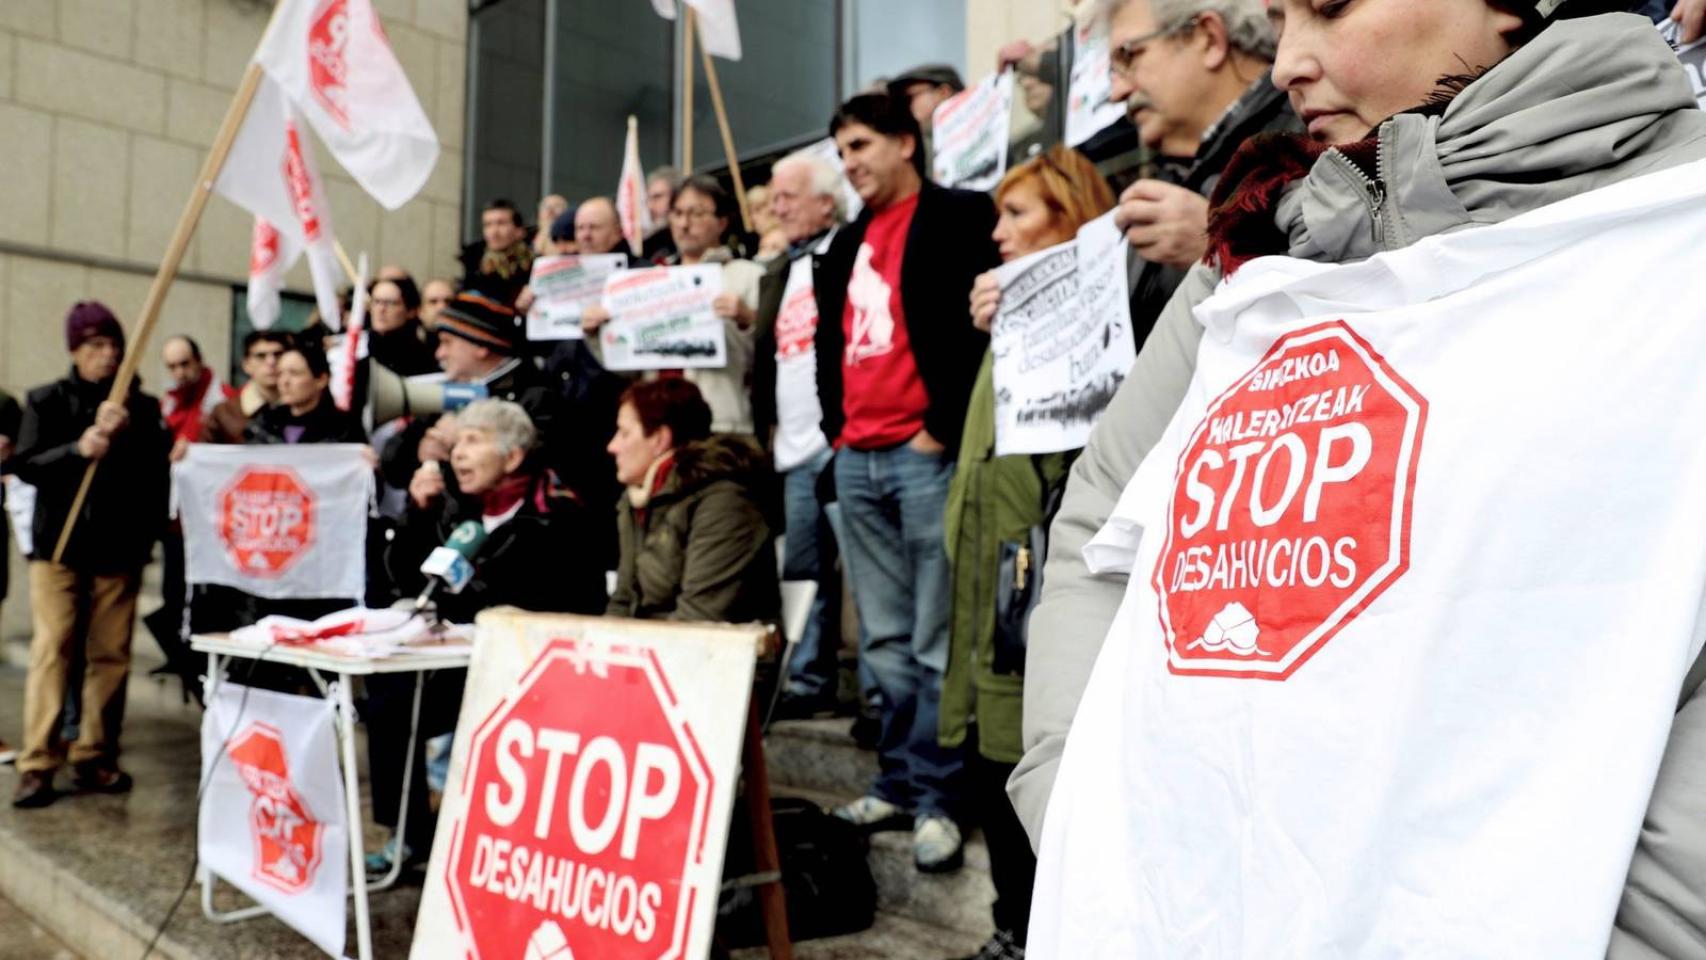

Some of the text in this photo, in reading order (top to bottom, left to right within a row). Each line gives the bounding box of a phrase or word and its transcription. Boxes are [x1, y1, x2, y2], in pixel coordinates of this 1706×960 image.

[233, 505, 302, 540] STOP
[1180, 421, 1373, 539] STOP
[1170, 535, 1357, 594] DESAHUCIOS
[485, 718, 682, 861] STOP
[469, 833, 662, 943] DESAHUCIOS
